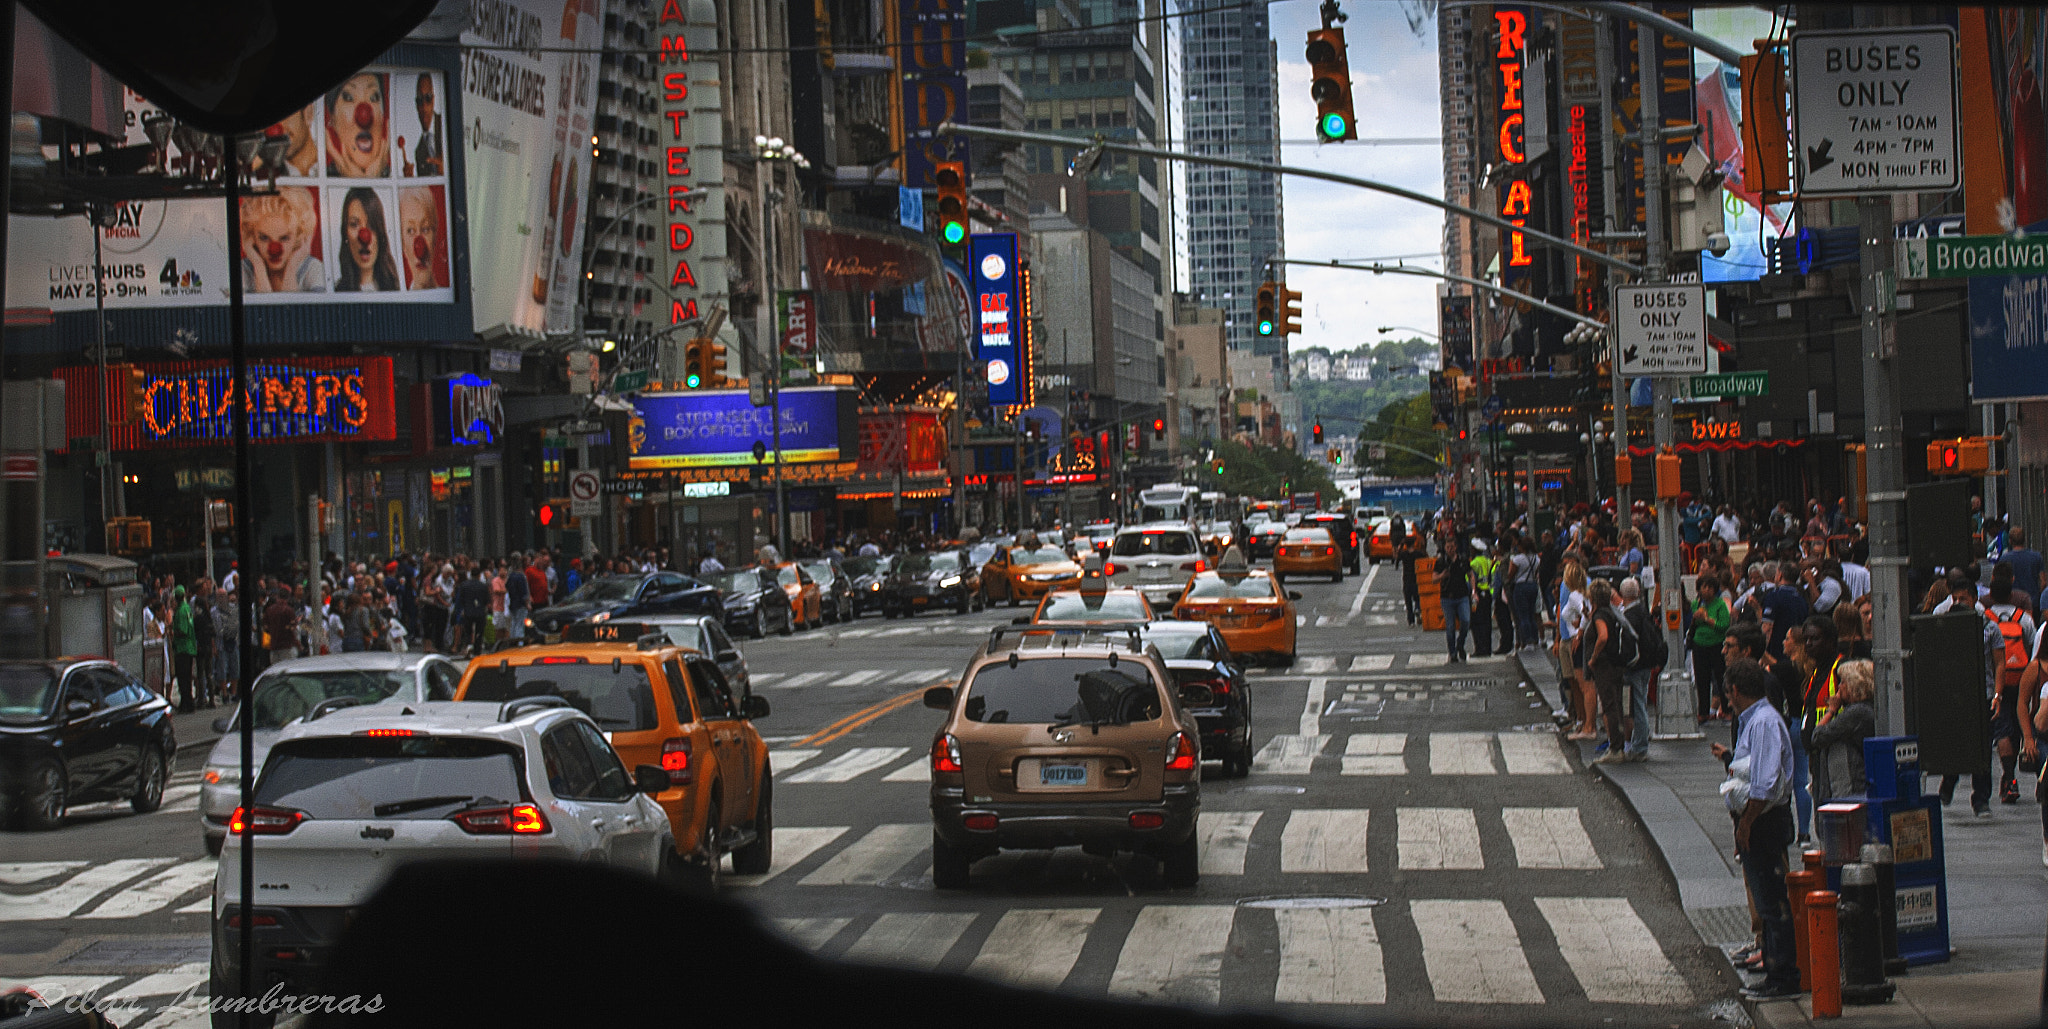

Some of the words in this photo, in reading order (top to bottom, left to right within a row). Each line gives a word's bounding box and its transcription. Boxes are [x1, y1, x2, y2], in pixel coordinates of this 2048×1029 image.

[1826, 45, 1921, 73] BUSES
[502, 59, 546, 119] CALORIES
[1837, 79, 1911, 107] ONLY
[1848, 116, 1882, 132] 7AM
[1896, 114, 1937, 131] 10AM
[1495, 10, 1532, 267] REGAL
[1853, 139, 1887, 155] 4PM
[1901, 138, 1934, 153] 7PM
[660, 0, 698, 325] AMSTERDAM
[1841, 162, 1880, 179] MON
[1885, 163, 1915, 176] THRU
[1919, 158, 1947, 176] FRI
[104, 228, 141, 239] SPECIAL
[1936, 239, 2048, 271] Broadwa
[50, 265, 89, 282] LIVE!
[160, 258, 180, 288] 4
[50, 283, 82, 300] MAY
[161, 288, 179, 296] NEW
[1633, 291, 1687, 309] BUSES
[981, 293, 1009, 312] EAT.
[788, 297, 808, 350] ART
[1640, 312, 1681, 328] ONLY
[1646, 332, 1665, 342] 7AM
[1673, 331, 1696, 341] 10AM
[1649, 344, 1668, 354] 4PM
[1677, 344, 1694, 354] 7PM
[1642, 358, 1664, 367] MON
[1686, 357, 1701, 367] FRI
[1695, 375, 1764, 396] Broadway
[143, 375, 368, 437] CHAMPS
[676, 411, 713, 426] STEP
[715, 408, 762, 423] INSIDE
[664, 426, 694, 440] BOX
[699, 424, 751, 438] OFFICE
[687, 482, 729, 497] ALDO
[361, 826, 395, 841] Jeep
